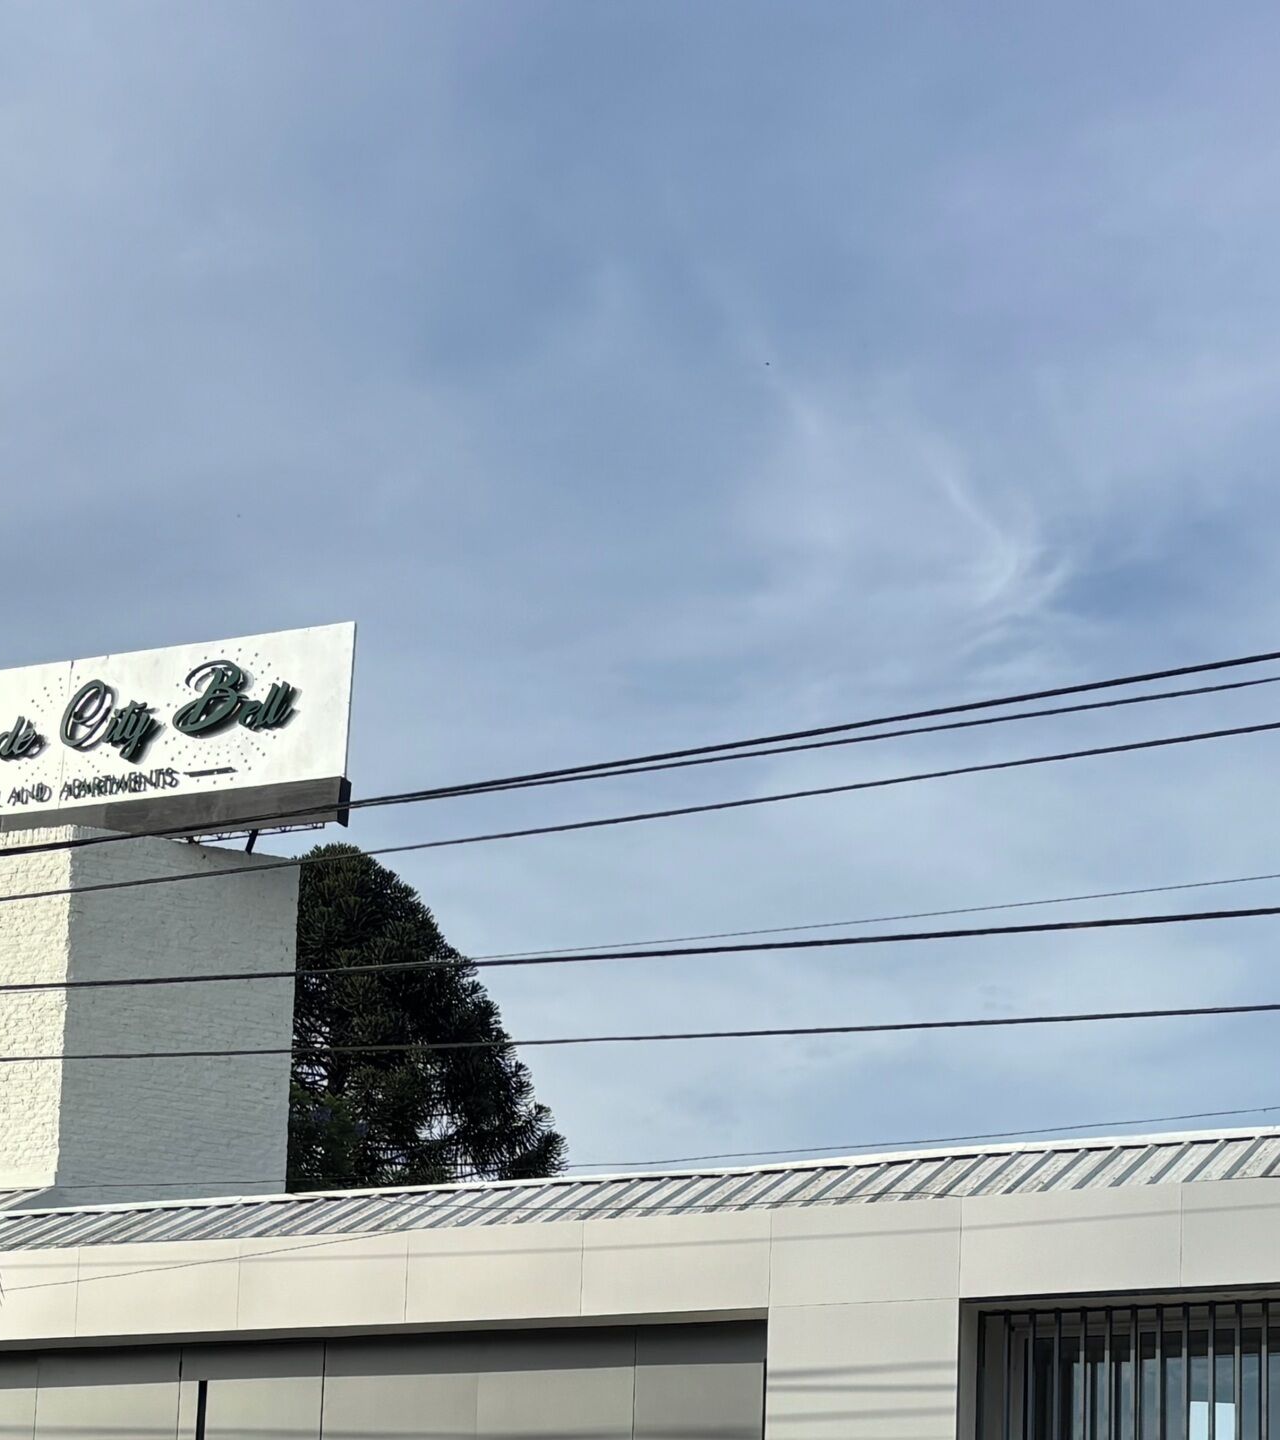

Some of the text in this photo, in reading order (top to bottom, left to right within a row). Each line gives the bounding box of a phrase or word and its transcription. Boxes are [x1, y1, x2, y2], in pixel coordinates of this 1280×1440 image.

[59, 679, 156, 761] City
[172, 659, 294, 733] Bell
[7, 781, 52, 806] AND
[59, 767, 180, 800] APARTMENTS
